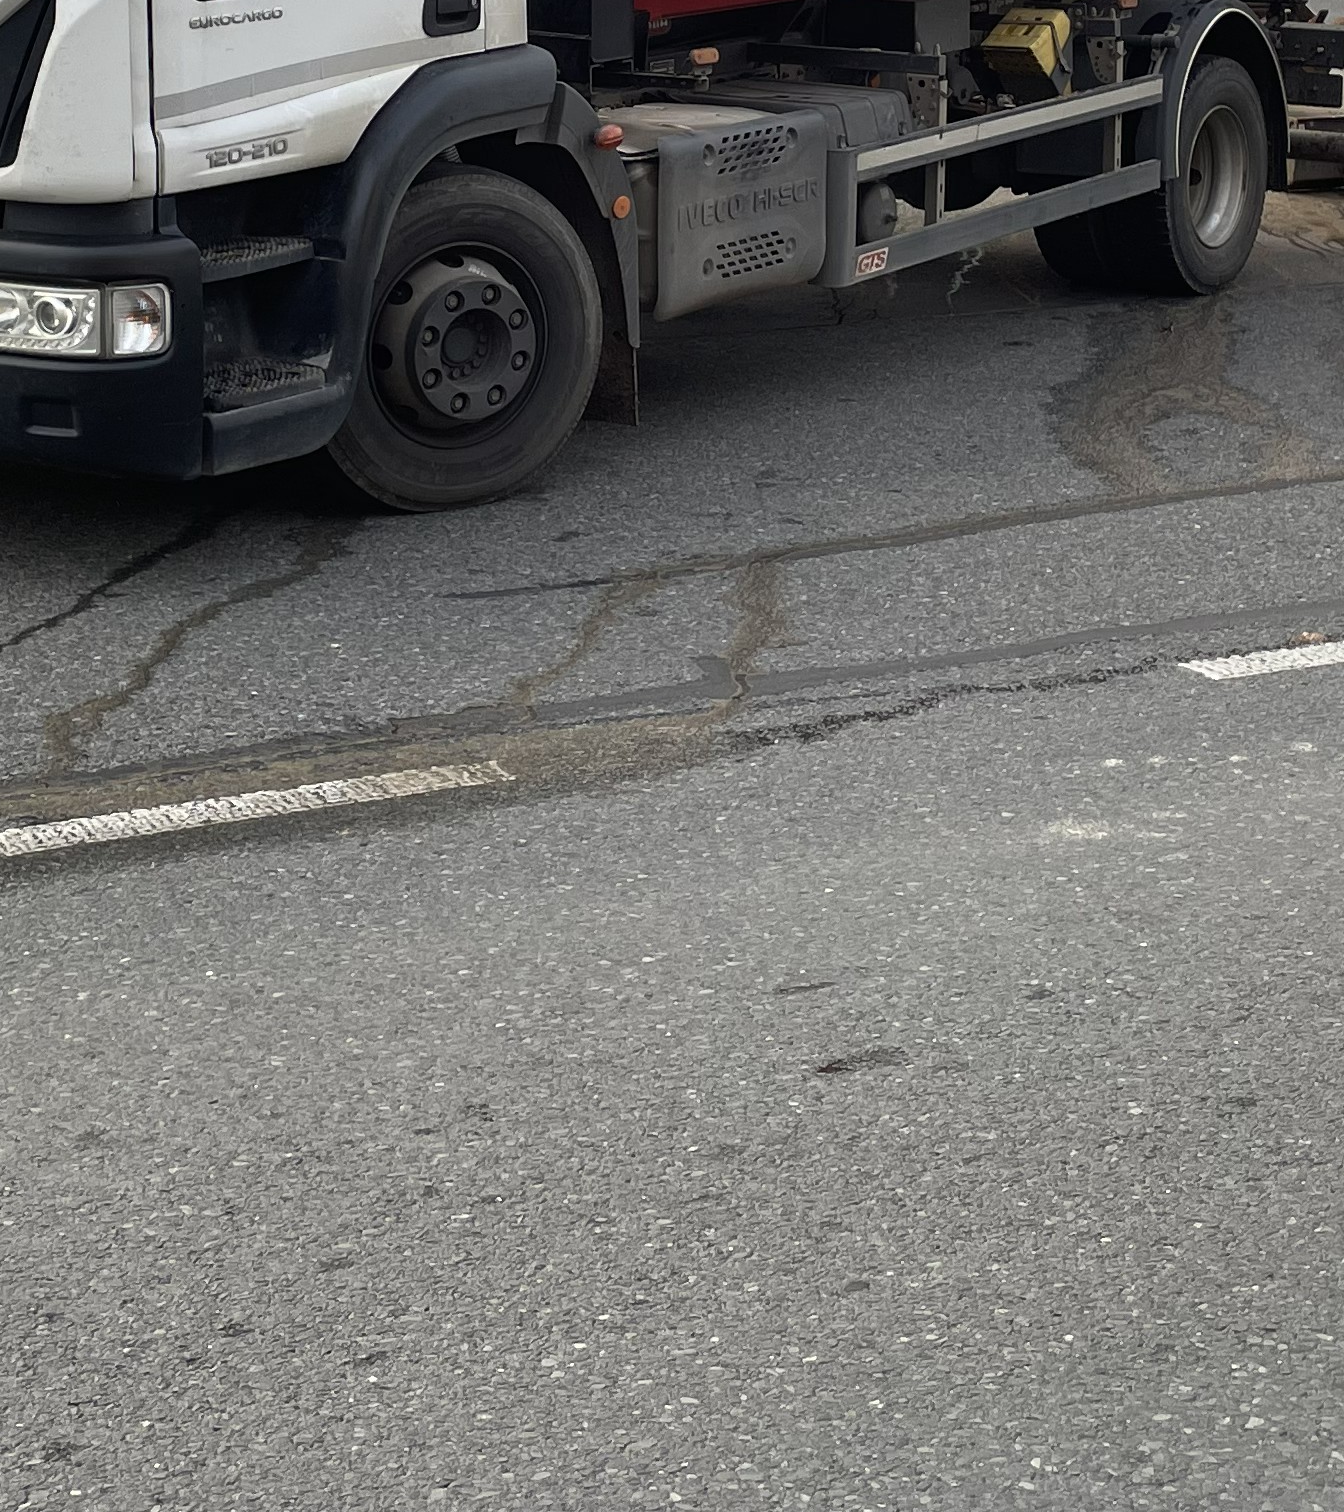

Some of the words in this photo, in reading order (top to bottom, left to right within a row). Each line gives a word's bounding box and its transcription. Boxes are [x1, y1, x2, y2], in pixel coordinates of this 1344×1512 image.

[189, 7, 283, 29] EUROCARGO
[677, 194, 743, 231] IVECO
[859, 250, 887, 273] GTS
